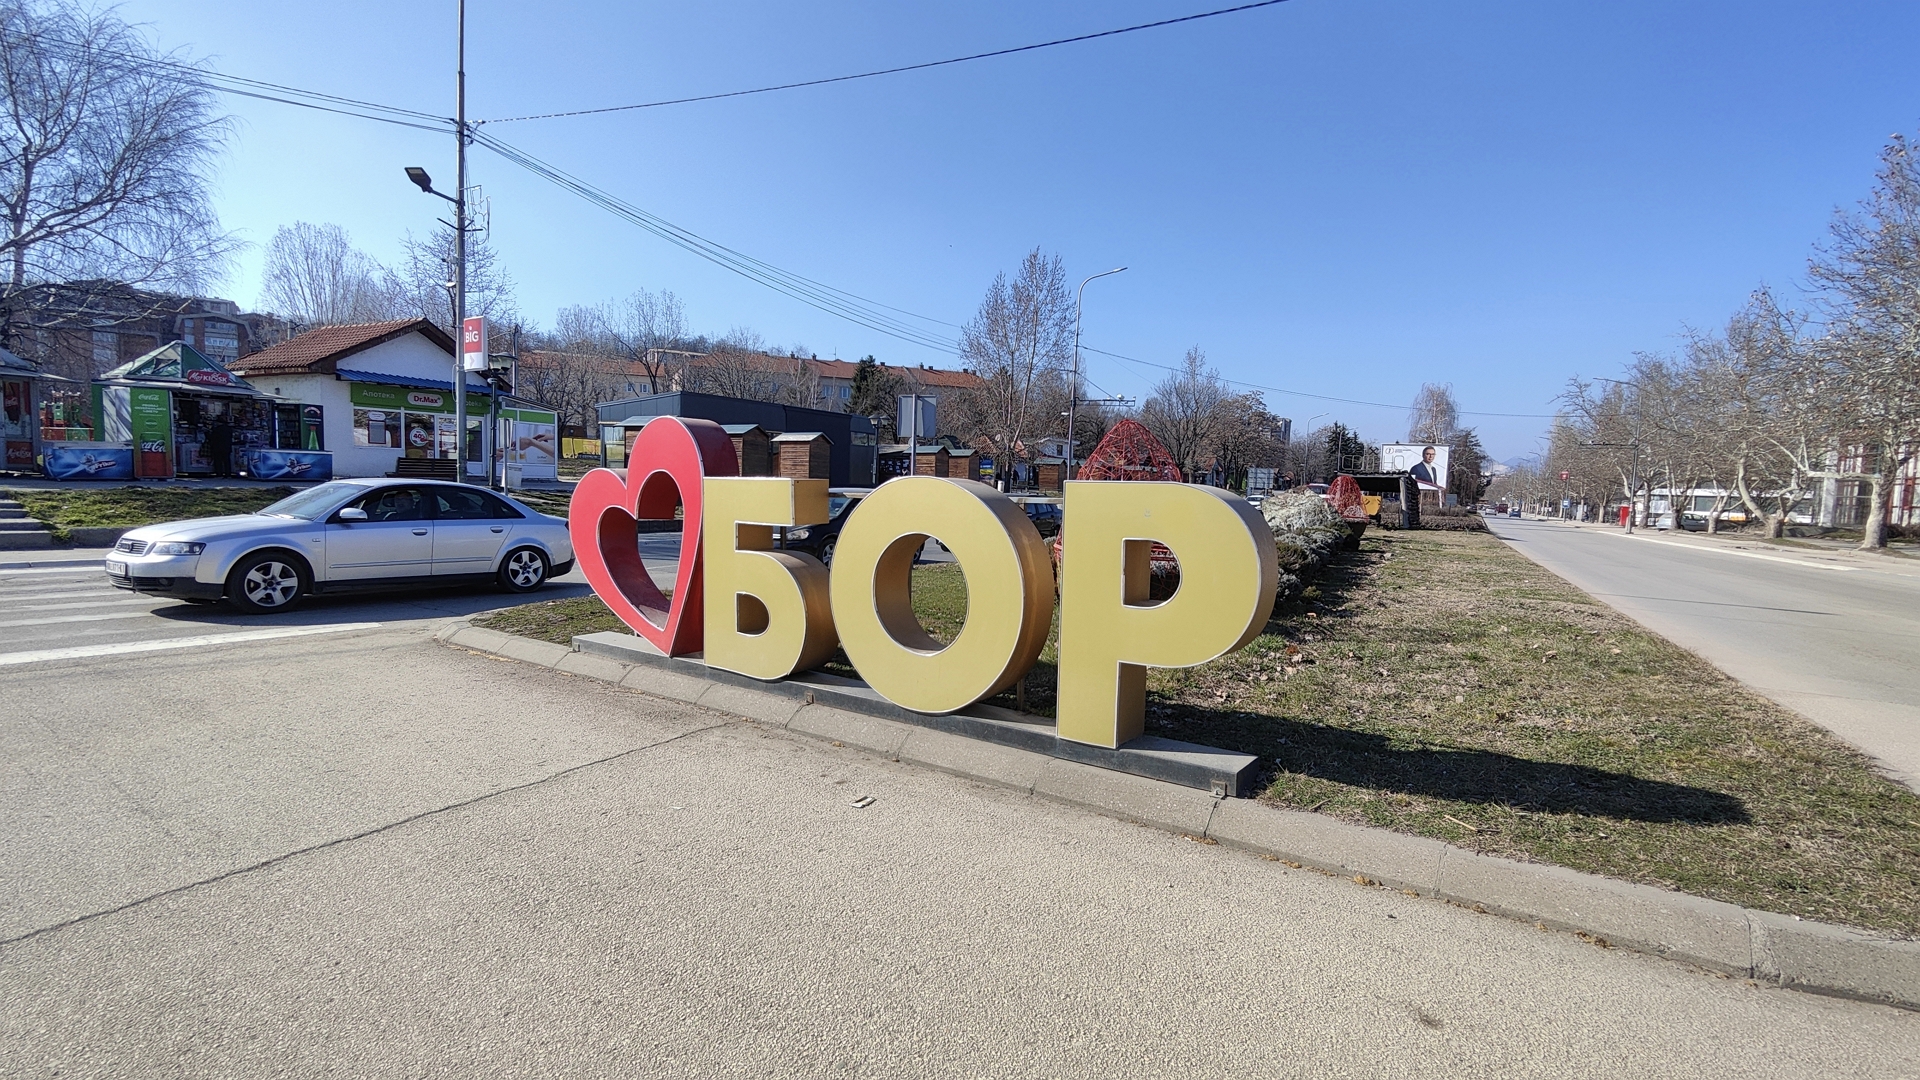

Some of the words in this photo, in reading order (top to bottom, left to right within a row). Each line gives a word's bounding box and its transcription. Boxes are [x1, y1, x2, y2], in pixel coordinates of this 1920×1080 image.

[465, 330, 479, 343] BIG
[362, 389, 396, 399] Апотека
[413, 395, 438, 404] Dr.Max
[702, 475, 1265, 749] БОР
